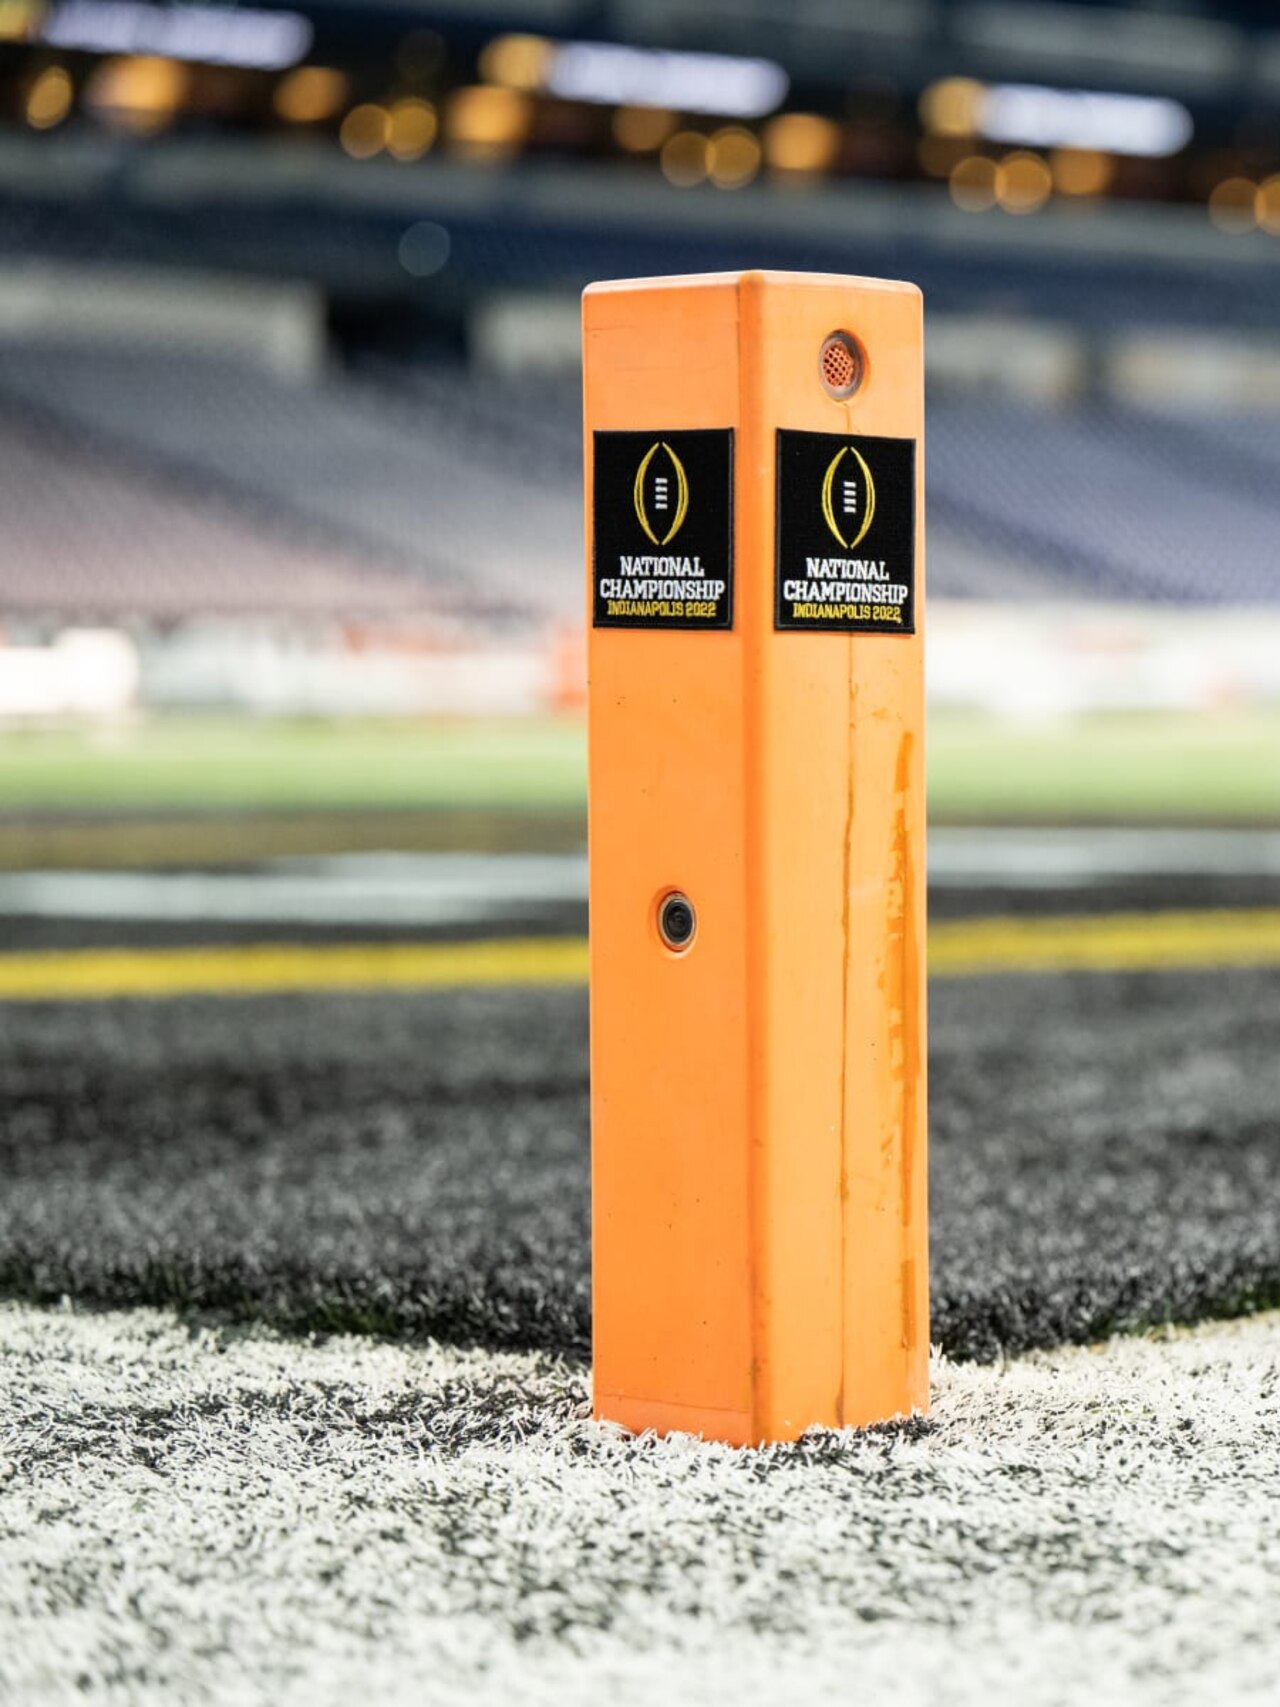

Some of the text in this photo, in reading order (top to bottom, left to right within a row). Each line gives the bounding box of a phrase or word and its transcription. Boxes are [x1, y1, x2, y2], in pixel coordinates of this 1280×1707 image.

[620, 556, 705, 577] NATIONAL
[806, 557, 890, 580] NATIONAL
[600, 578, 725, 600] CHAMPIONSHIP
[783, 580, 908, 604] CHAMPIONSHIP
[607, 600, 717, 618] INDIANAPOLIS 2022
[793, 603, 901, 622] INDIANAPOLIS 2022
